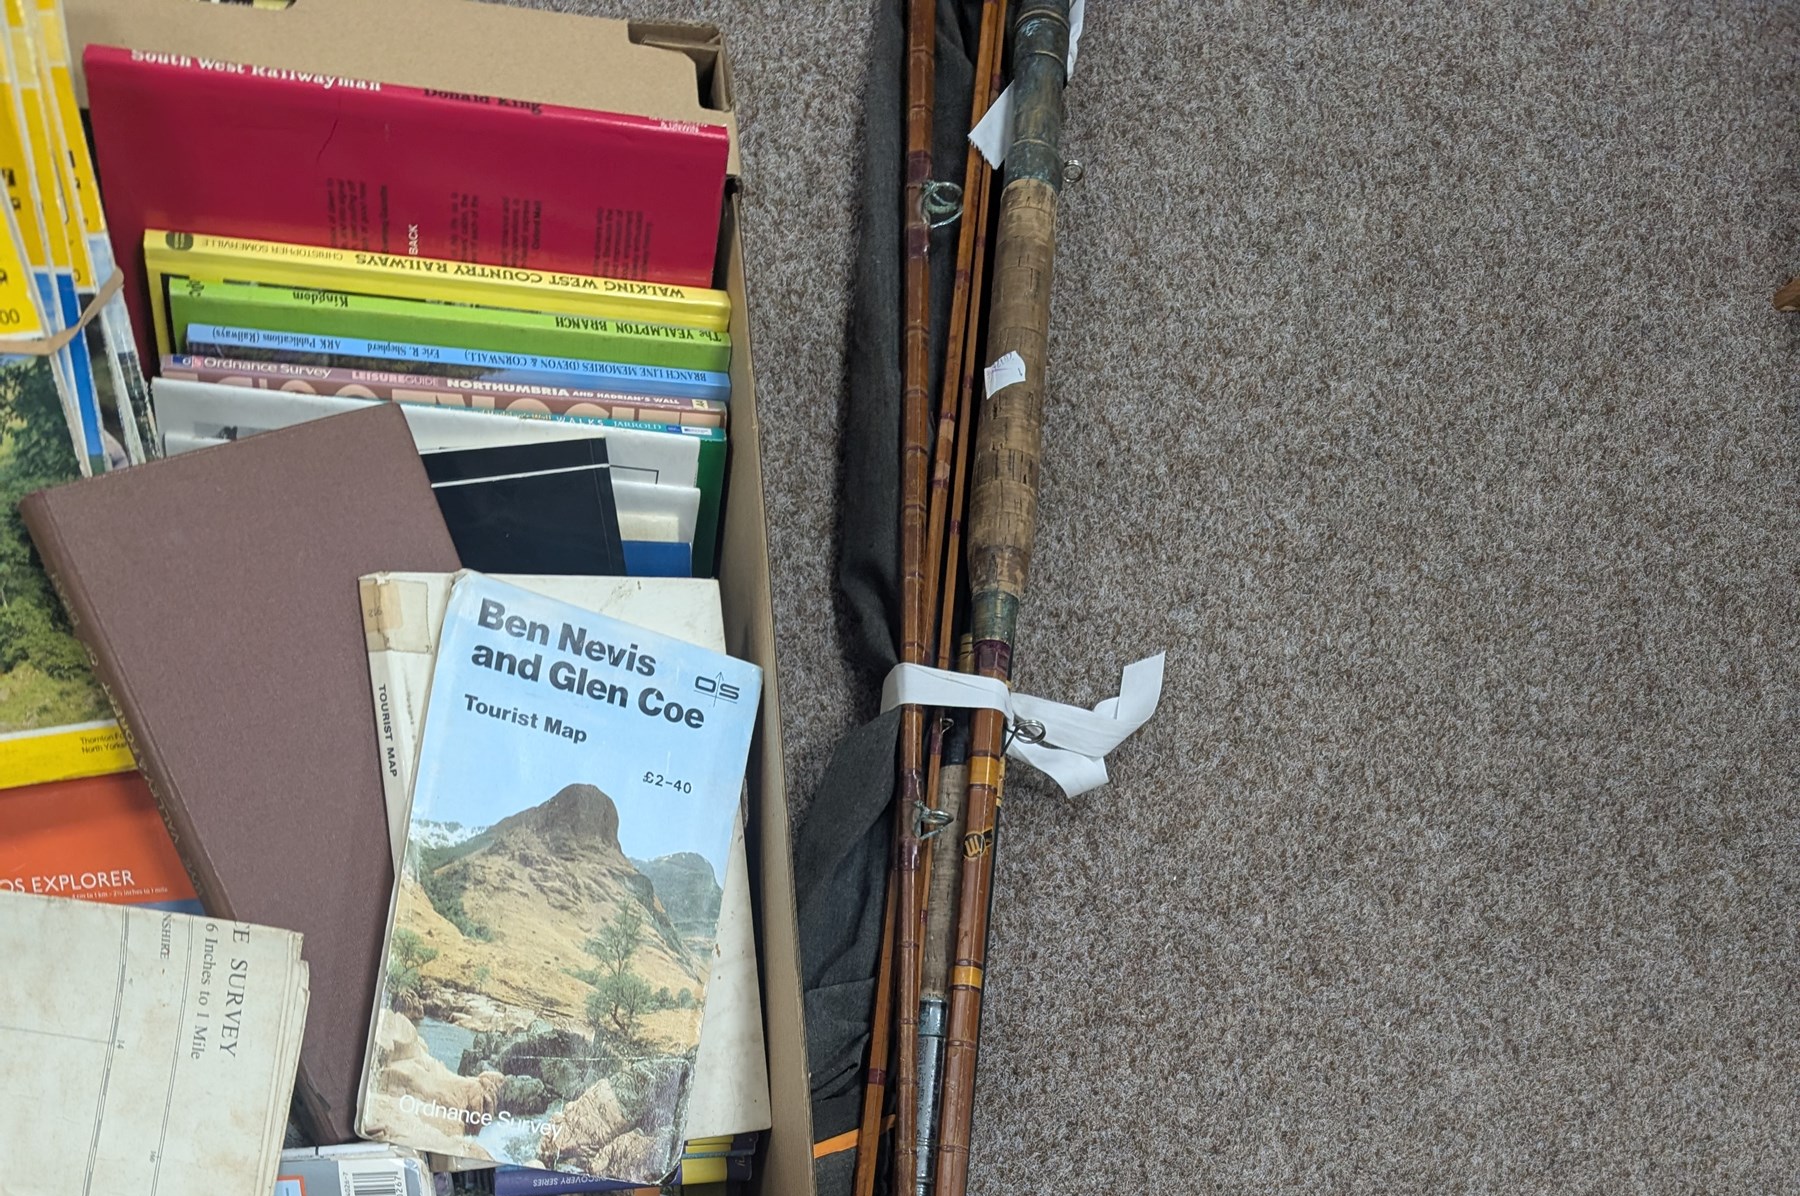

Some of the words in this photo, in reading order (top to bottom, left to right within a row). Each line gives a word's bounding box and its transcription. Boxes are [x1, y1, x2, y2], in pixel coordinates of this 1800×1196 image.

[131, 49, 191, 67] South
[198, 57, 245, 74] West
[251, 65, 381, 91] Railwayman
[202, 239, 269, 254] SOMERVILLE
[408, 224, 418, 255] BACK
[270, 245, 344, 261] CHRISTOPHER
[355, 254, 448, 275] RAILWAYS
[453, 264, 543, 284] COUNTRY
[549, 273, 599, 291] WEST
[604, 280, 685, 299] WALKING
[292, 291, 349, 308] Kingdom
[554, 316, 608, 332] BRANCH
[615, 322, 694, 340] YEALMPTON
[211, 327, 260, 345] (Railways)
[262, 333, 316, 348] Publications
[319, 339, 341, 351] ARK
[699, 329, 721, 343] The
[367, 342, 407, 356] Shepherd
[408, 346, 418, 357] R.
[420, 347, 440, 360] Eric
[464, 349, 527, 367] CORNWALL)
[530, 358, 538, 368] &
[540, 359, 580, 373] (DEVON
[582, 361, 637, 377] MEMORIES
[203, 357, 278, 373] Ordnance
[280, 363, 332, 379] Survey
[447, 379, 570, 397] NORTHUMBRIA
[572, 390, 594, 398] AND
[597, 391, 650, 403] HADRIAN'S
[652, 397, 680, 405] WALL
[640, 366, 663, 379] LINE
[666, 368, 707, 382] BRANCH
[556, 415, 603, 427] WALKS
[614, 420, 661, 430] JARROLD
[50, 572, 80, 626] DEAN
[477, 597, 550, 646] Ben
[558, 622, 657, 677] Nevis
[471, 643, 543, 683] and
[549, 660, 629, 709] Glen
[637, 687, 705, 729] Coe
[101, 681, 140, 755] FOREST
[464, 694, 538, 730] Tourist
[543, 716, 588, 744] Map
[378, 683, 393, 741] TOURIST
[387, 747, 397, 778] MAP
[642, 771, 693, 795] £2-40
[145, 774, 181, 844] VALLEY
[0, 878, 25, 894] OS
[31, 869, 135, 894] EXPLORER
[205, 922, 219, 932] 6
[232, 920, 250, 944] E
[200, 937, 218, 985] Inches
[198, 991, 211, 1006] to
[220, 958, 249, 1057] SURVEY
[190, 1025, 208, 1060] Mile
[399, 1094, 493, 1126] Ordnance
[497, 1110, 563, 1141] Survey
[533, 1177, 559, 1188] SERIES
